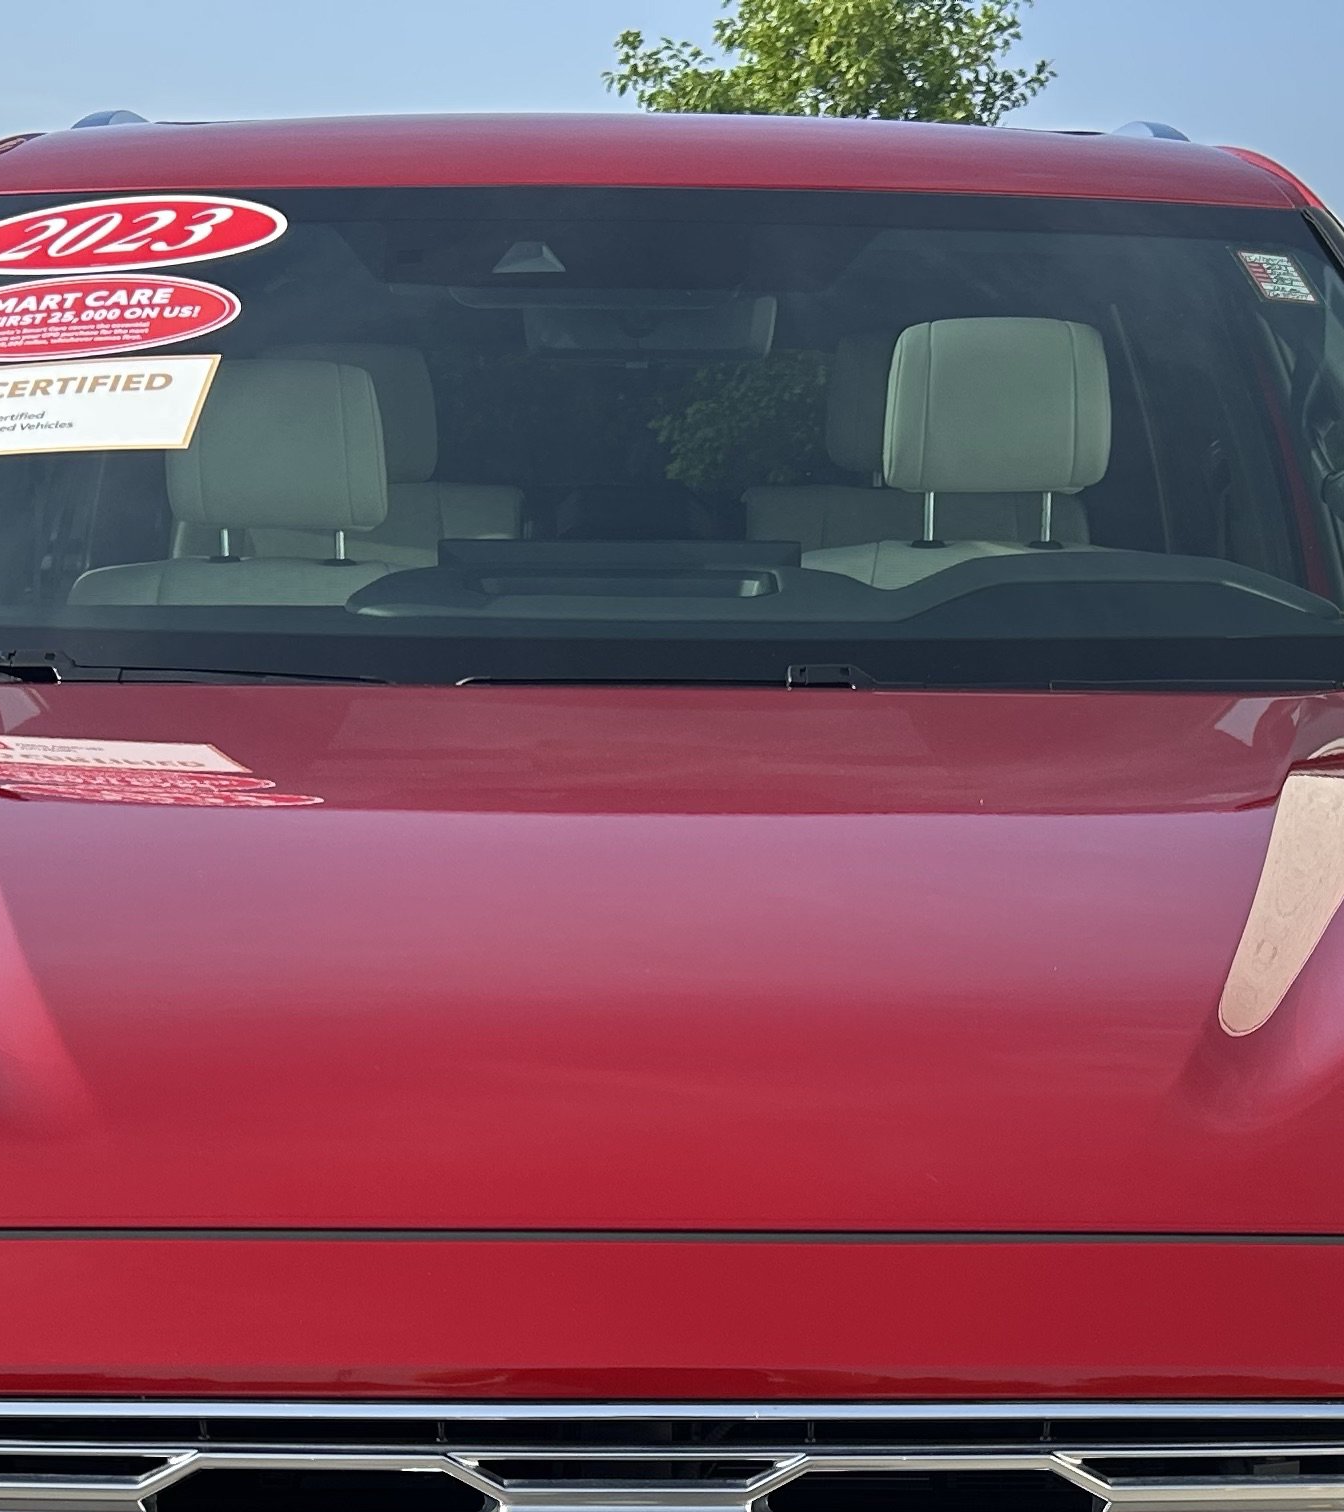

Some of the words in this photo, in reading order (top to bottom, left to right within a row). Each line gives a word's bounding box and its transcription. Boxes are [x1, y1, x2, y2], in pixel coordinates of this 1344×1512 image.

[84, 287, 175, 307] CARE
[46, 307, 121, 324] 25,000
[124, 305, 159, 320] ON
[162, 304, 202, 319] US!
[19, 419, 74, 432] Vehicles
